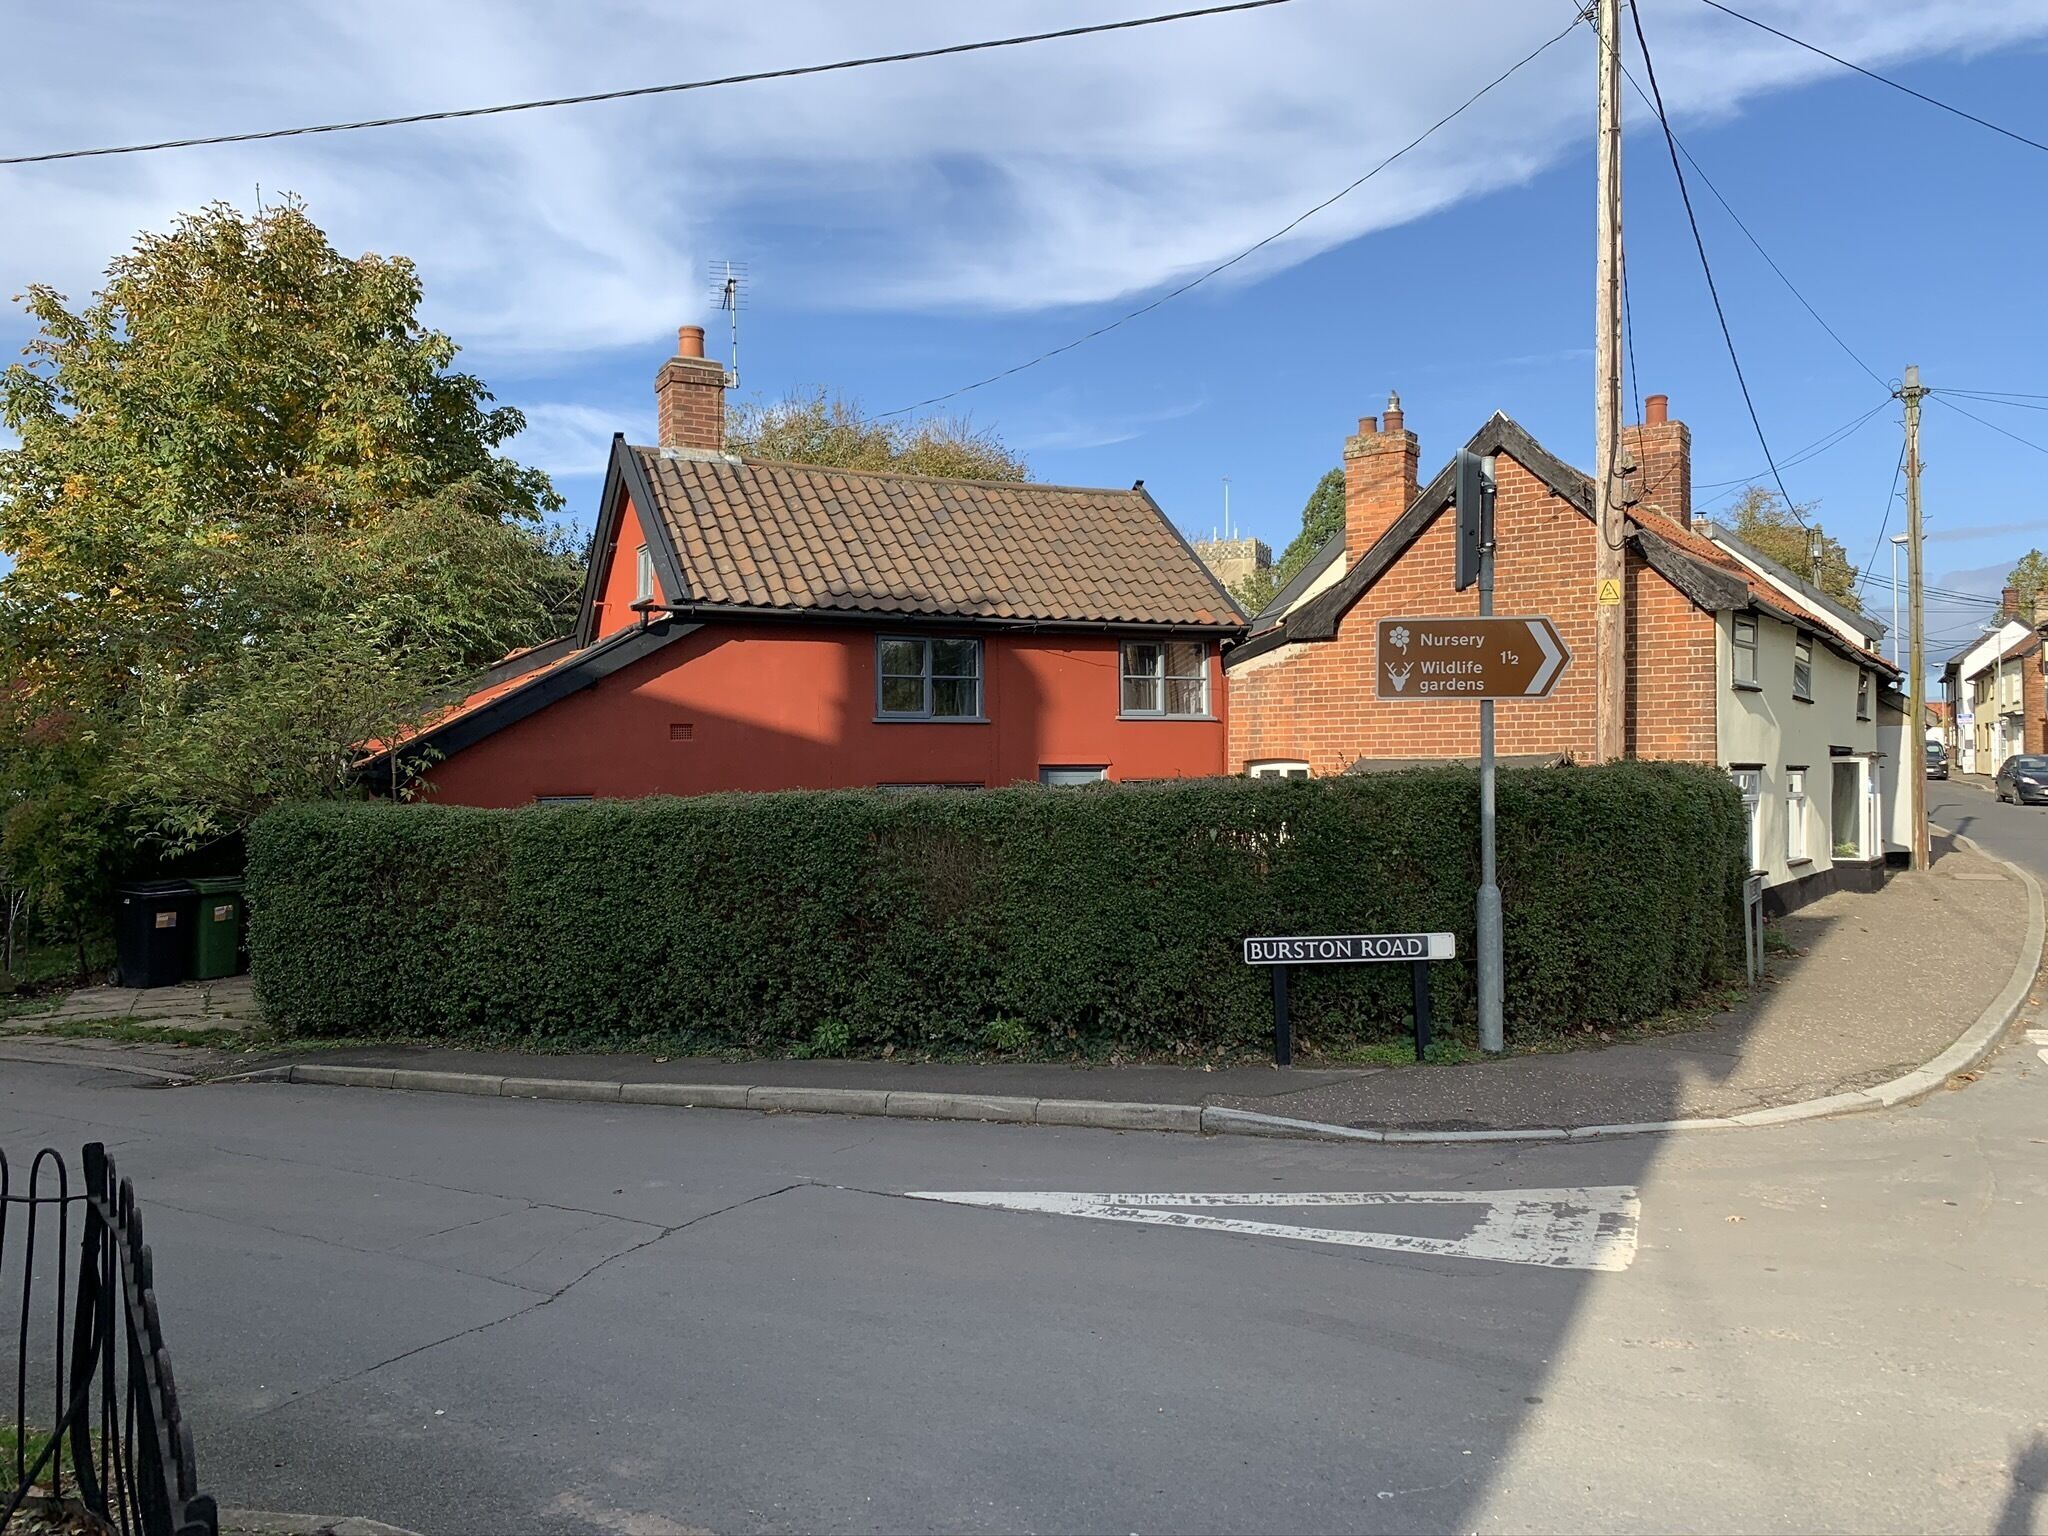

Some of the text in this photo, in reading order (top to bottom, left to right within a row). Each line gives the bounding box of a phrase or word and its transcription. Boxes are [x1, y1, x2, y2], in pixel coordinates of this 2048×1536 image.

[1420, 633, 1485, 648] Nursery
[1421, 660, 1483, 674] Wildlife
[1420, 678, 1484, 693] gardens
[1250, 938, 1422, 960] BURSTON ROAD
